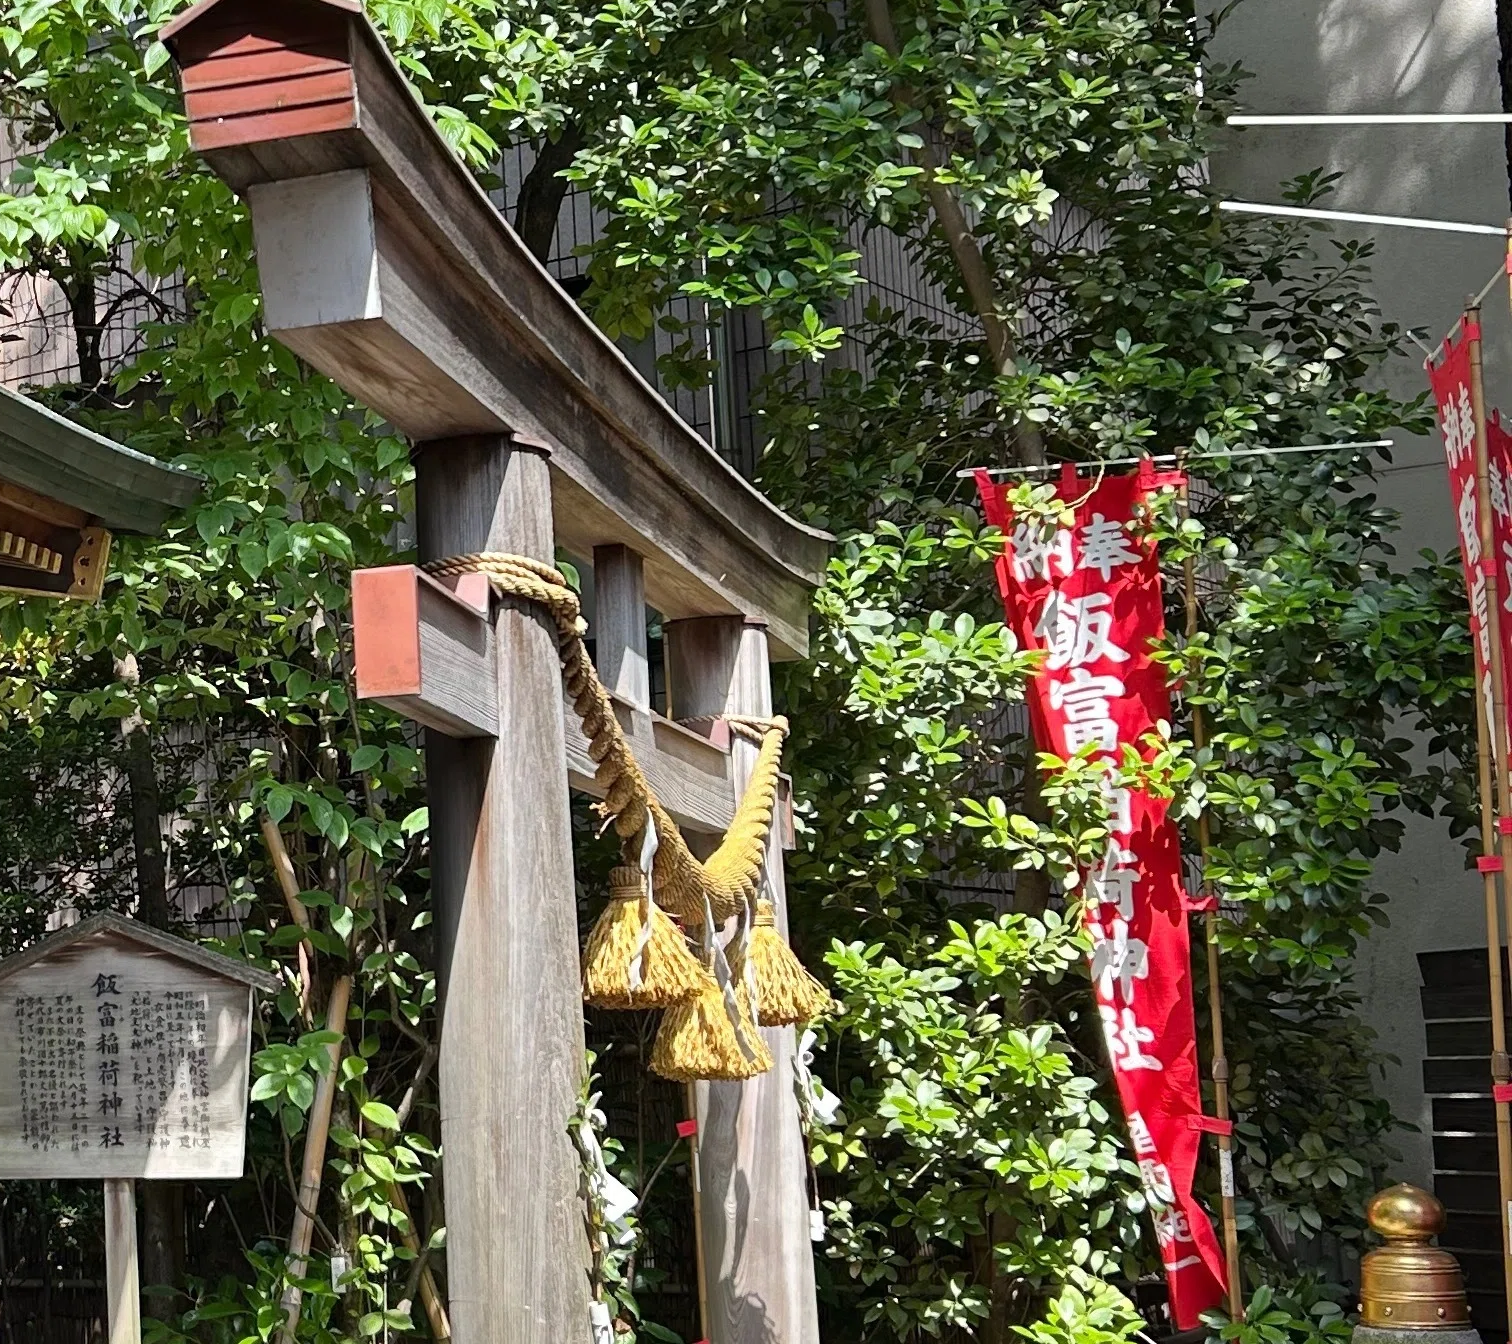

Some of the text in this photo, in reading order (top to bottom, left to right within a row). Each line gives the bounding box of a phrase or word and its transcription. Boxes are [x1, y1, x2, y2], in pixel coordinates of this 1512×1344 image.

[1012, 512, 1142, 583] 奉納
[91, 973, 124, 1149] 飯富稲荷神社
